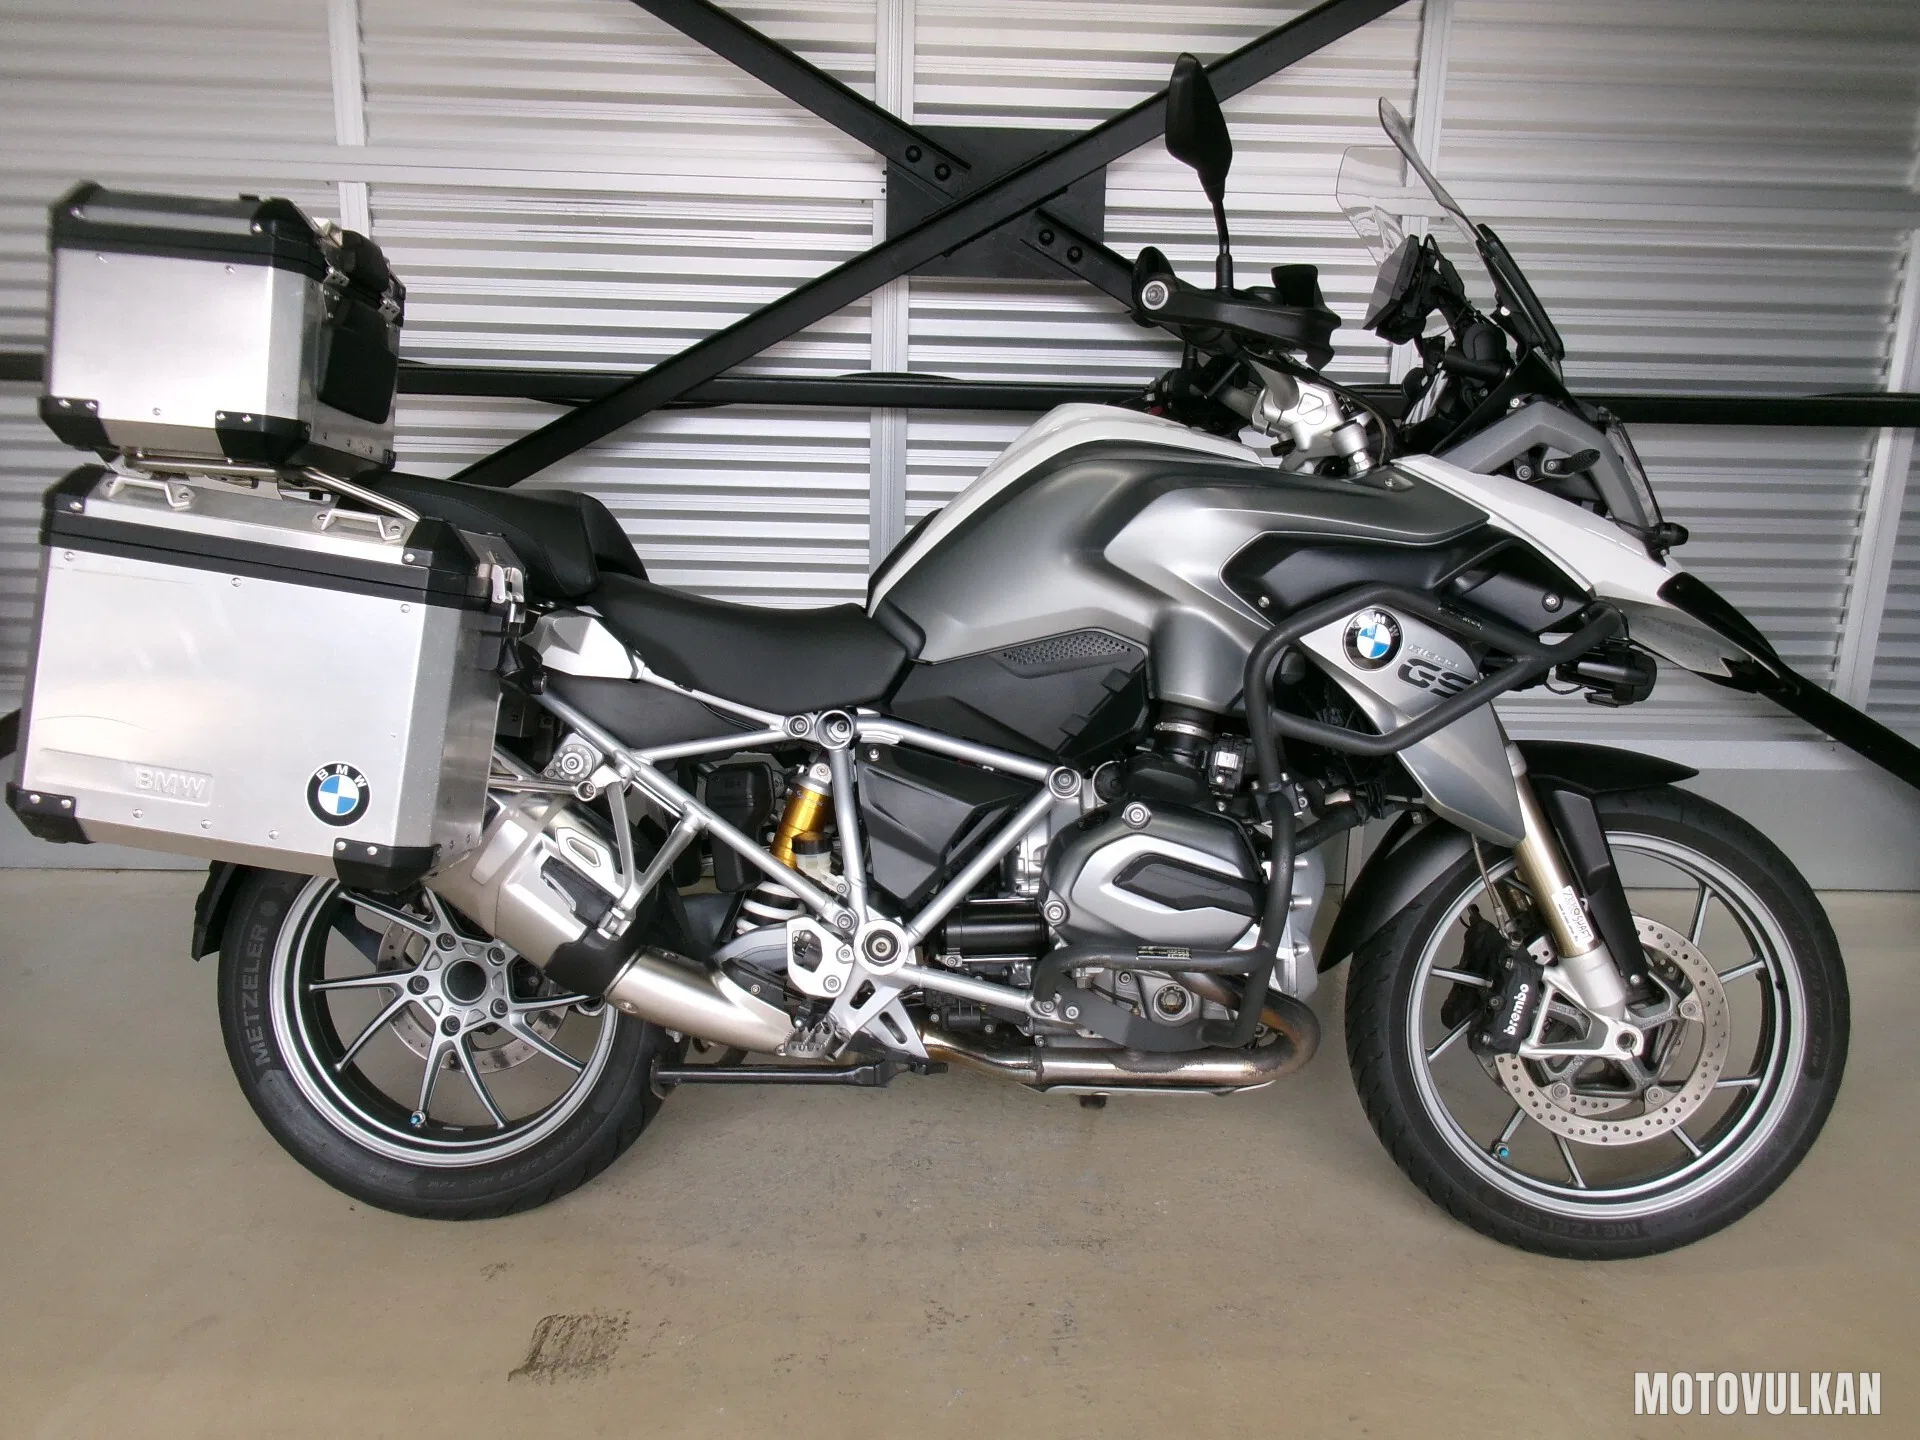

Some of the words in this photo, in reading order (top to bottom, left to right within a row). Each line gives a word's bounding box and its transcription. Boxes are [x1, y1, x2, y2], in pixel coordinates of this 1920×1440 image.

[1397, 658, 1477, 699] GS
[135, 767, 206, 799] BMW
[315, 764, 367, 788] BMW
[242, 924, 271, 1067] METZELER
[1503, 983, 1529, 1036] brembo
